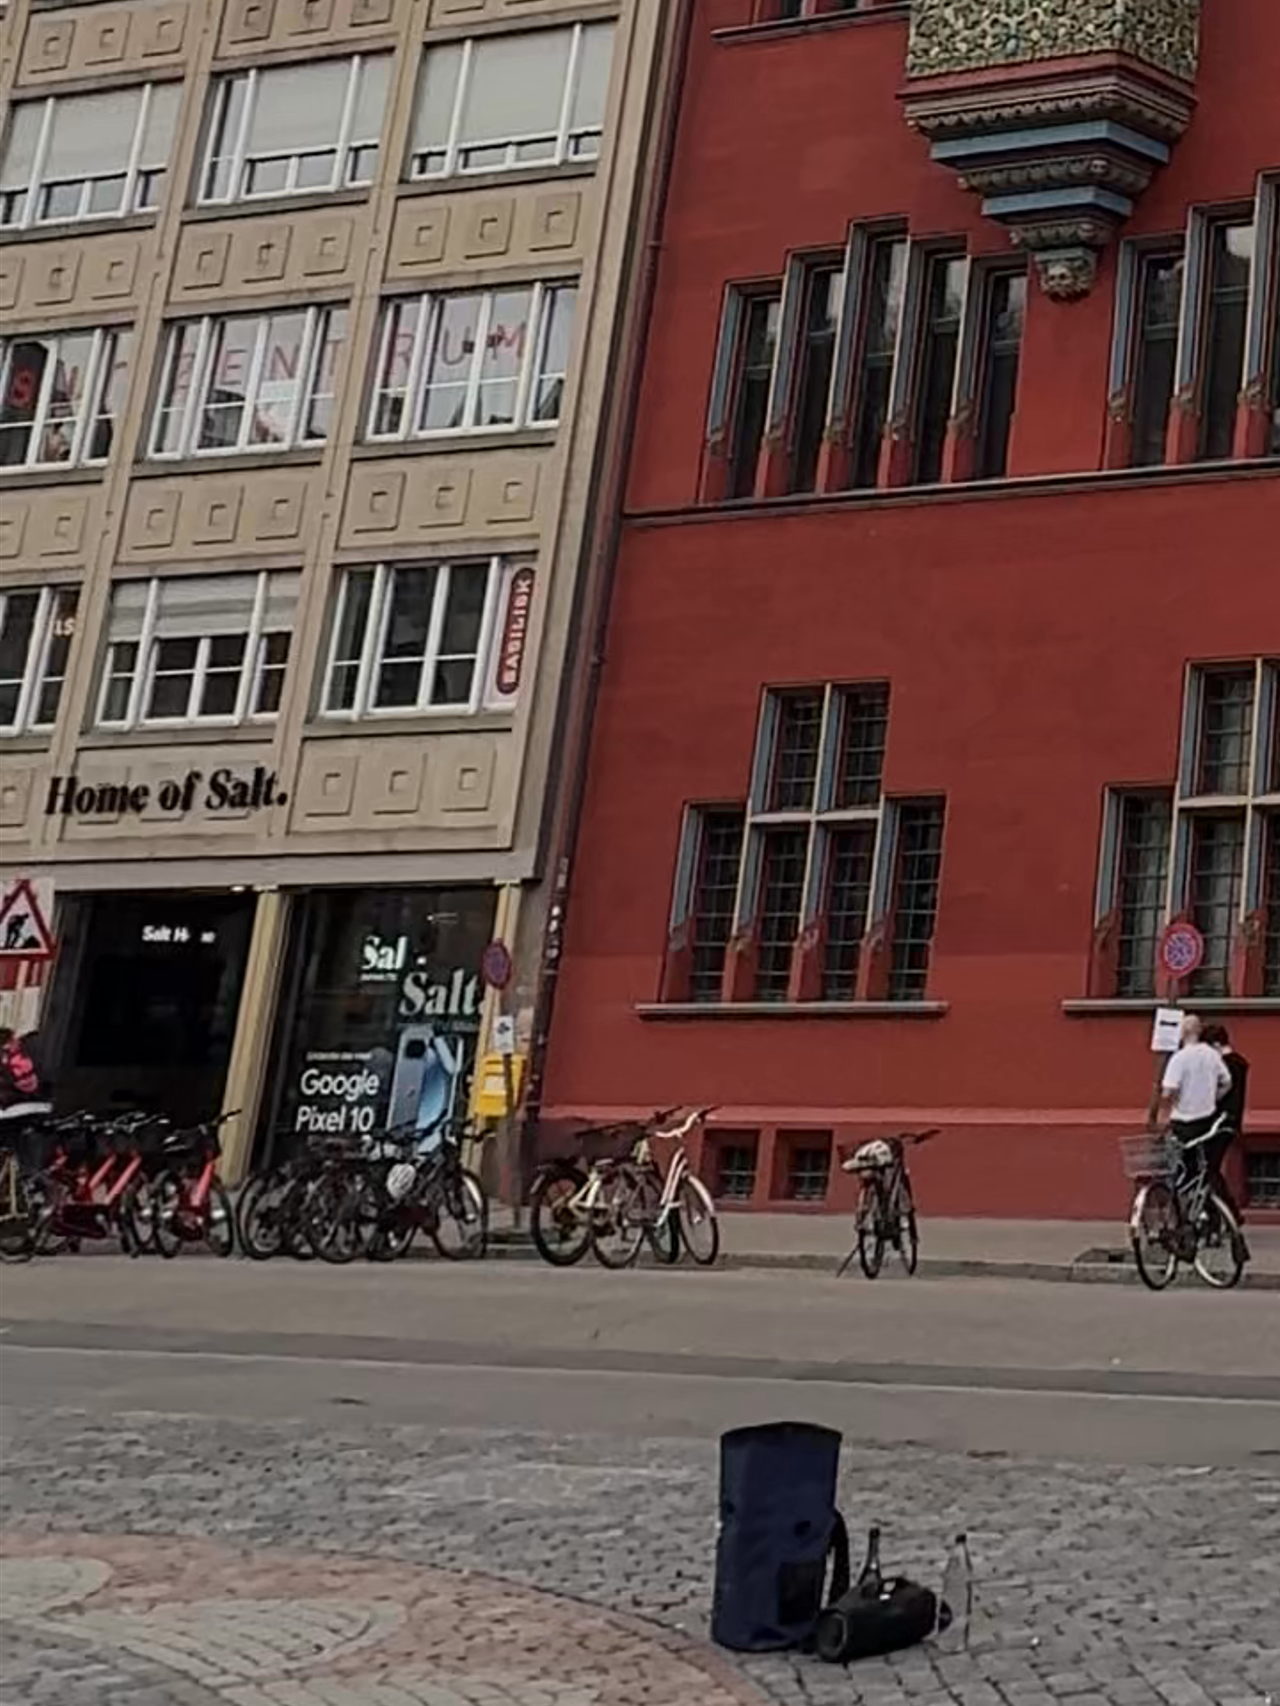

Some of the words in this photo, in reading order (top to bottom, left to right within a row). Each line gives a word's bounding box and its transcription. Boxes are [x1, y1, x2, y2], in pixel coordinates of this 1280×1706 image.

[45, 775, 150, 815] Home
[158, 770, 202, 812] of
[205, 766, 288, 810] Salt.
[301, 1068, 379, 1102] Google
[296, 1105, 346, 1132] Pixel
[350, 1106, 374, 1132] 10
